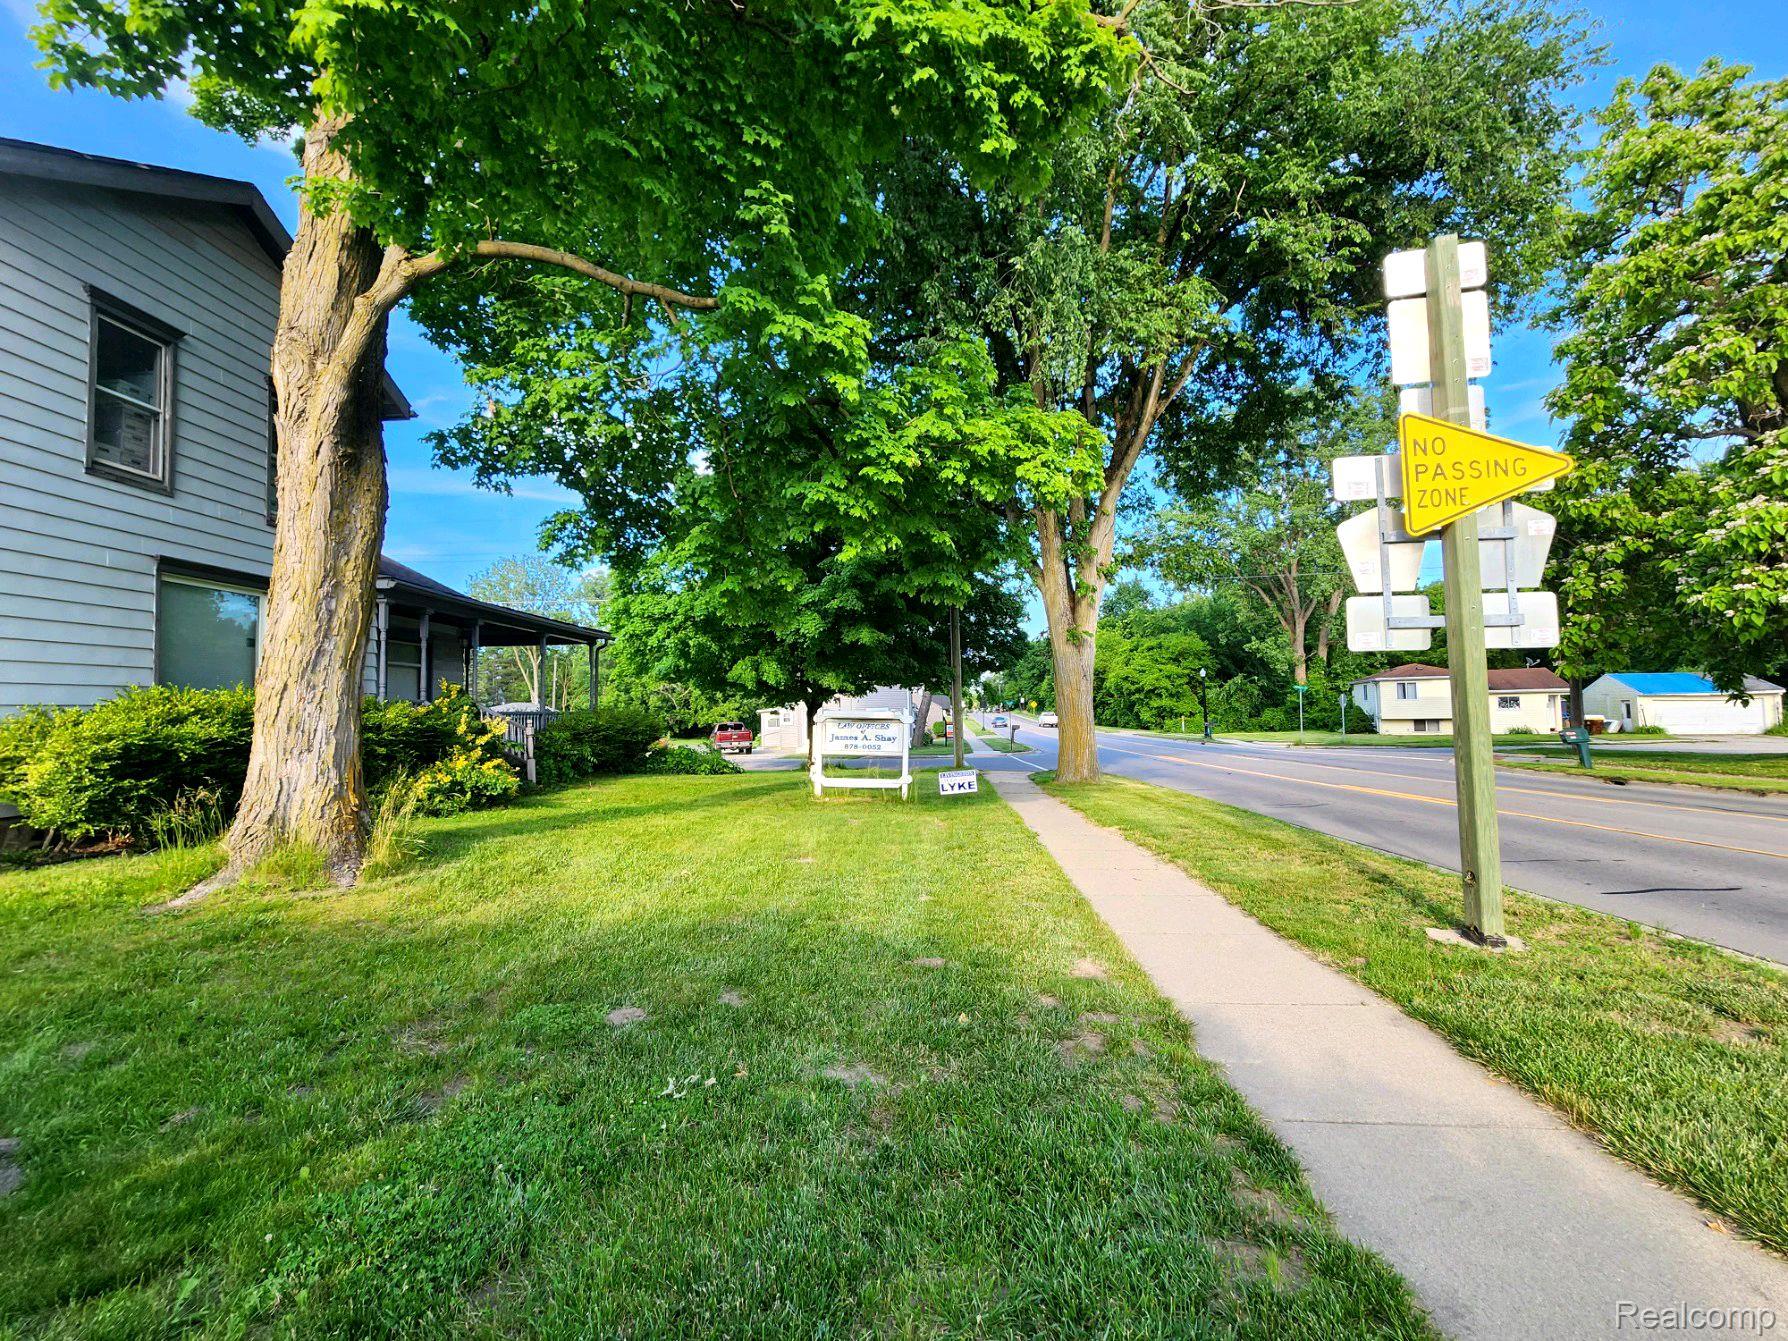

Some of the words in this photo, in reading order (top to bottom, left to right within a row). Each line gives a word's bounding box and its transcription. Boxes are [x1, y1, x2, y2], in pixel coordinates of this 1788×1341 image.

[1413, 436, 1446, 457] NO
[1415, 457, 1527, 482] PASSING
[1417, 487, 1470, 509] ZONE
[855, 722, 891, 730] OFFICES
[829, 733, 858, 742] James
[874, 734, 898, 743] Shay
[941, 779, 976, 792] LYKE
